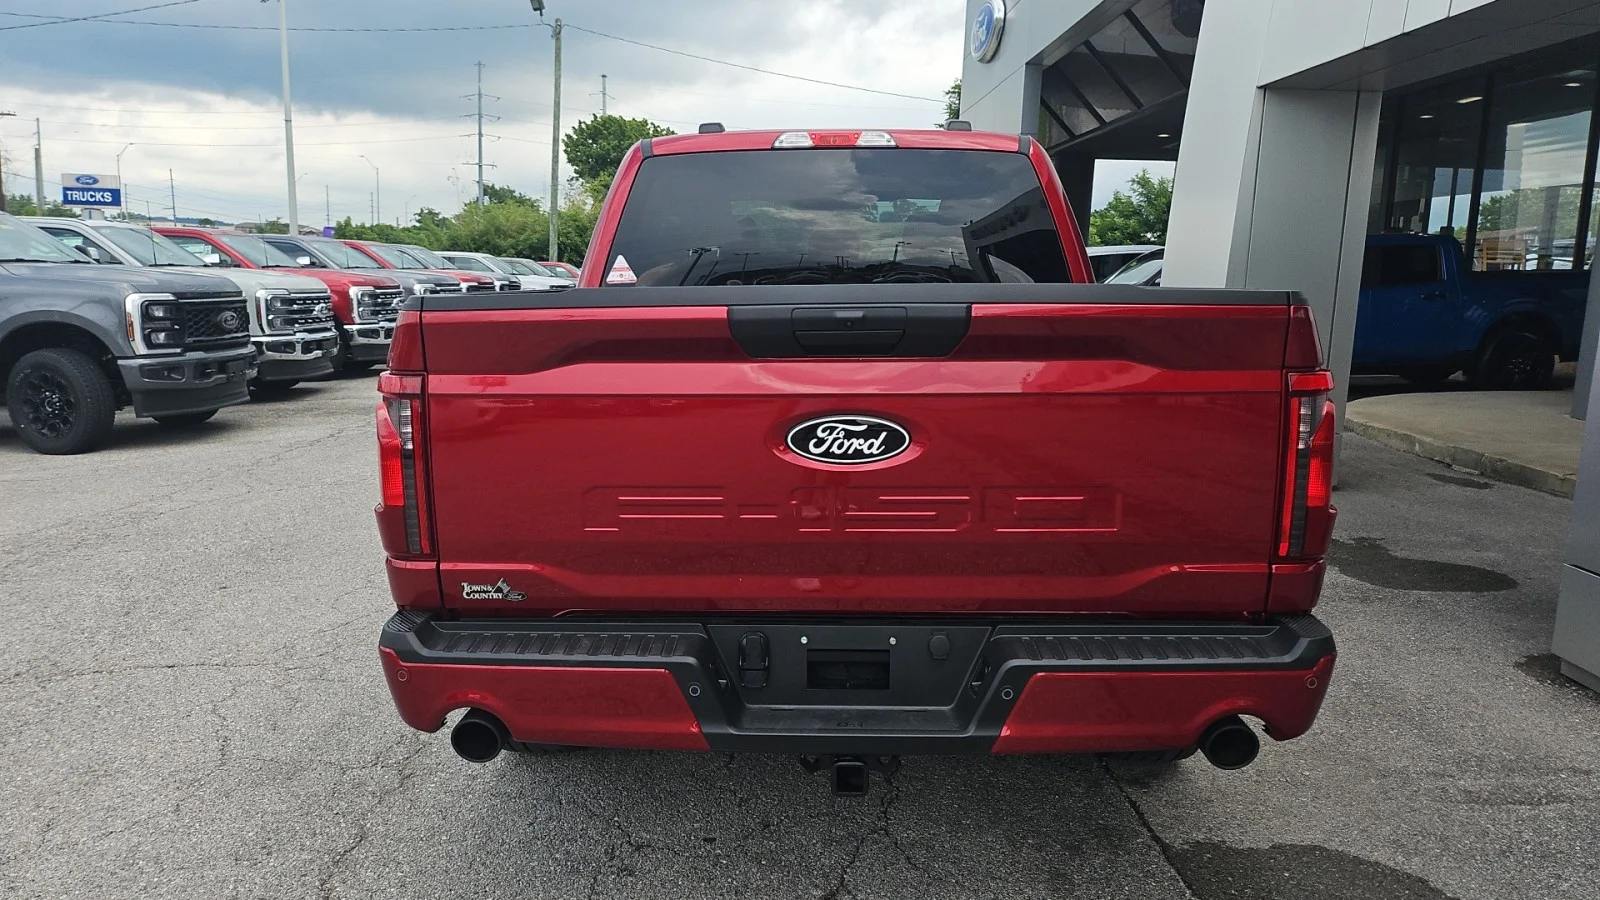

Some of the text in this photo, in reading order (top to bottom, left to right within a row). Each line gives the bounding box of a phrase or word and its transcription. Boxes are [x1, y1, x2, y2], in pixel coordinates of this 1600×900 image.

[66, 190, 112, 202] TRUCKS
[808, 422, 887, 454] Ford
[581, 485, 1123, 533] F-150
[462, 590, 503, 600] COUNTRY
